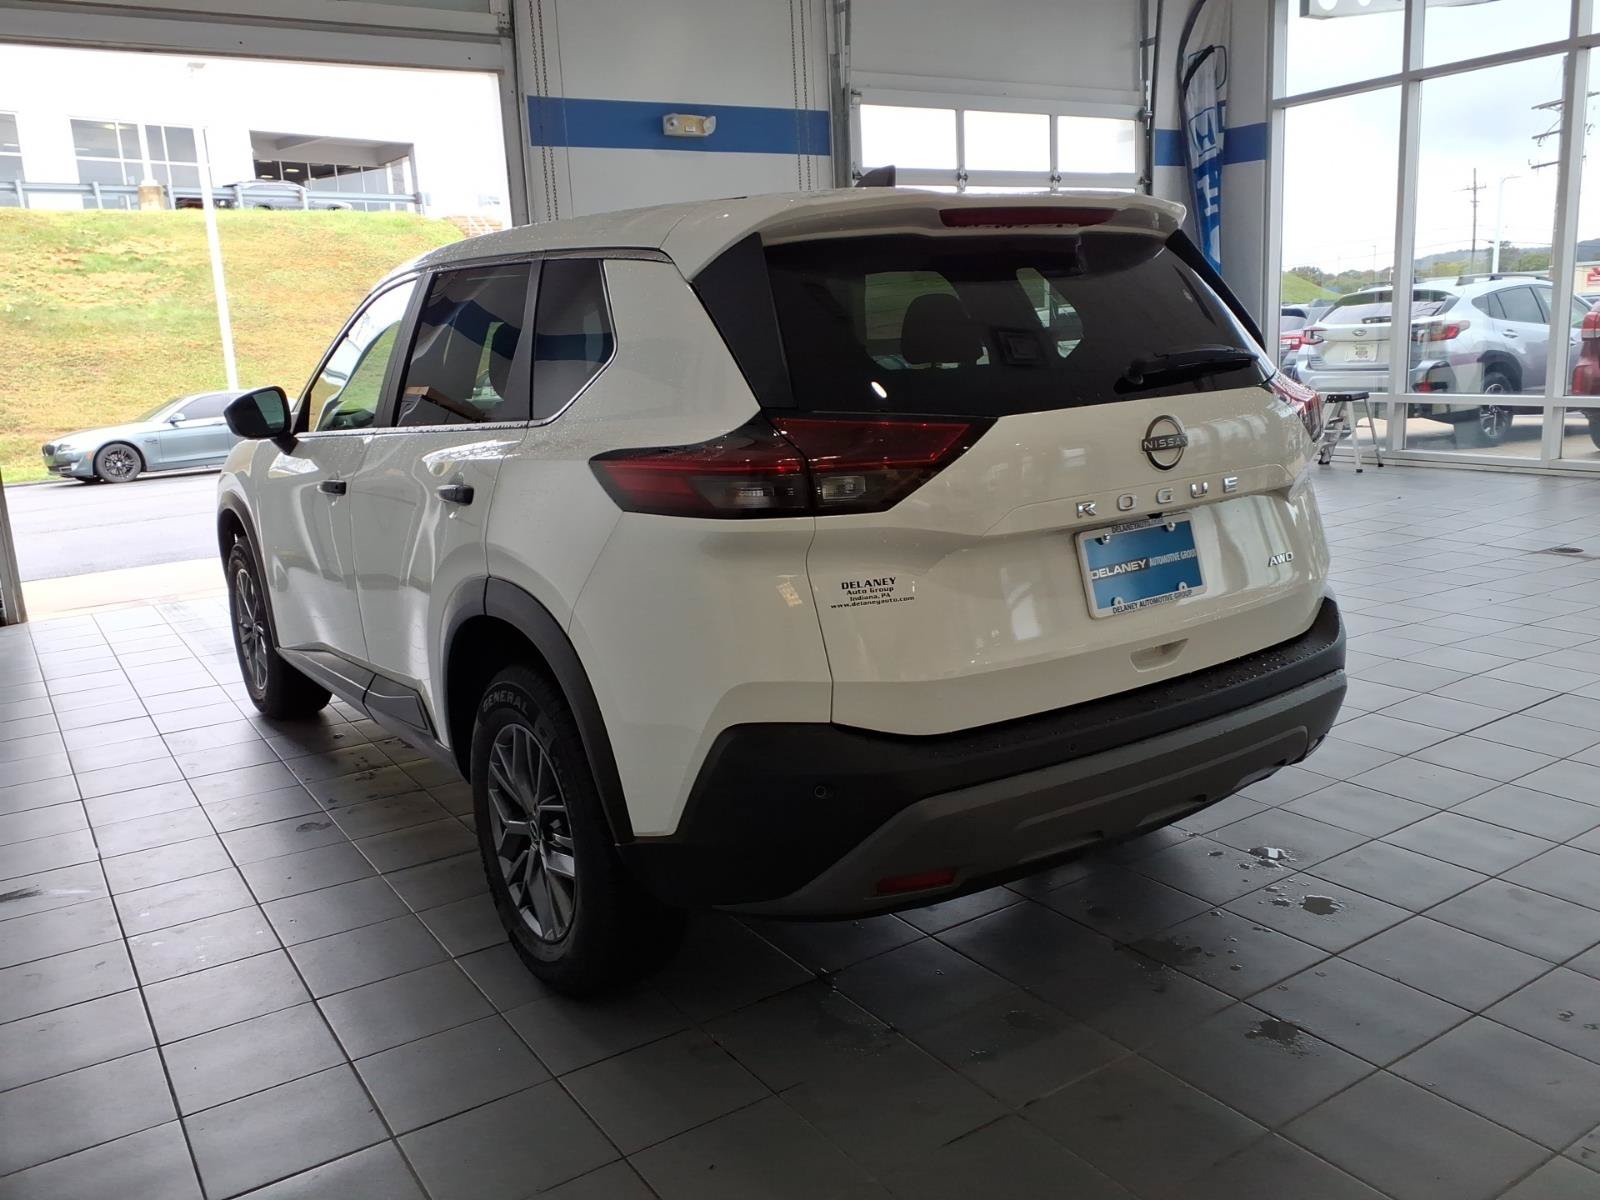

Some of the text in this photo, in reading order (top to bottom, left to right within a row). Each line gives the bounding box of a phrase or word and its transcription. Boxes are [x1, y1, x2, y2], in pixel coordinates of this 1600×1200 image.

[1077, 476, 1239, 518] ROGUE
[1091, 558, 1147, 580] DELANEY
[1268, 551, 1294, 567] AWD
[841, 577, 896, 589] DELANEY
[830, 596, 915, 608] www.delaneyauto.com
[1112, 602, 1138, 614] DELANEY
[1139, 593, 1174, 607] AUTOMOTIVE
[483, 689, 529, 716] GENERAL
